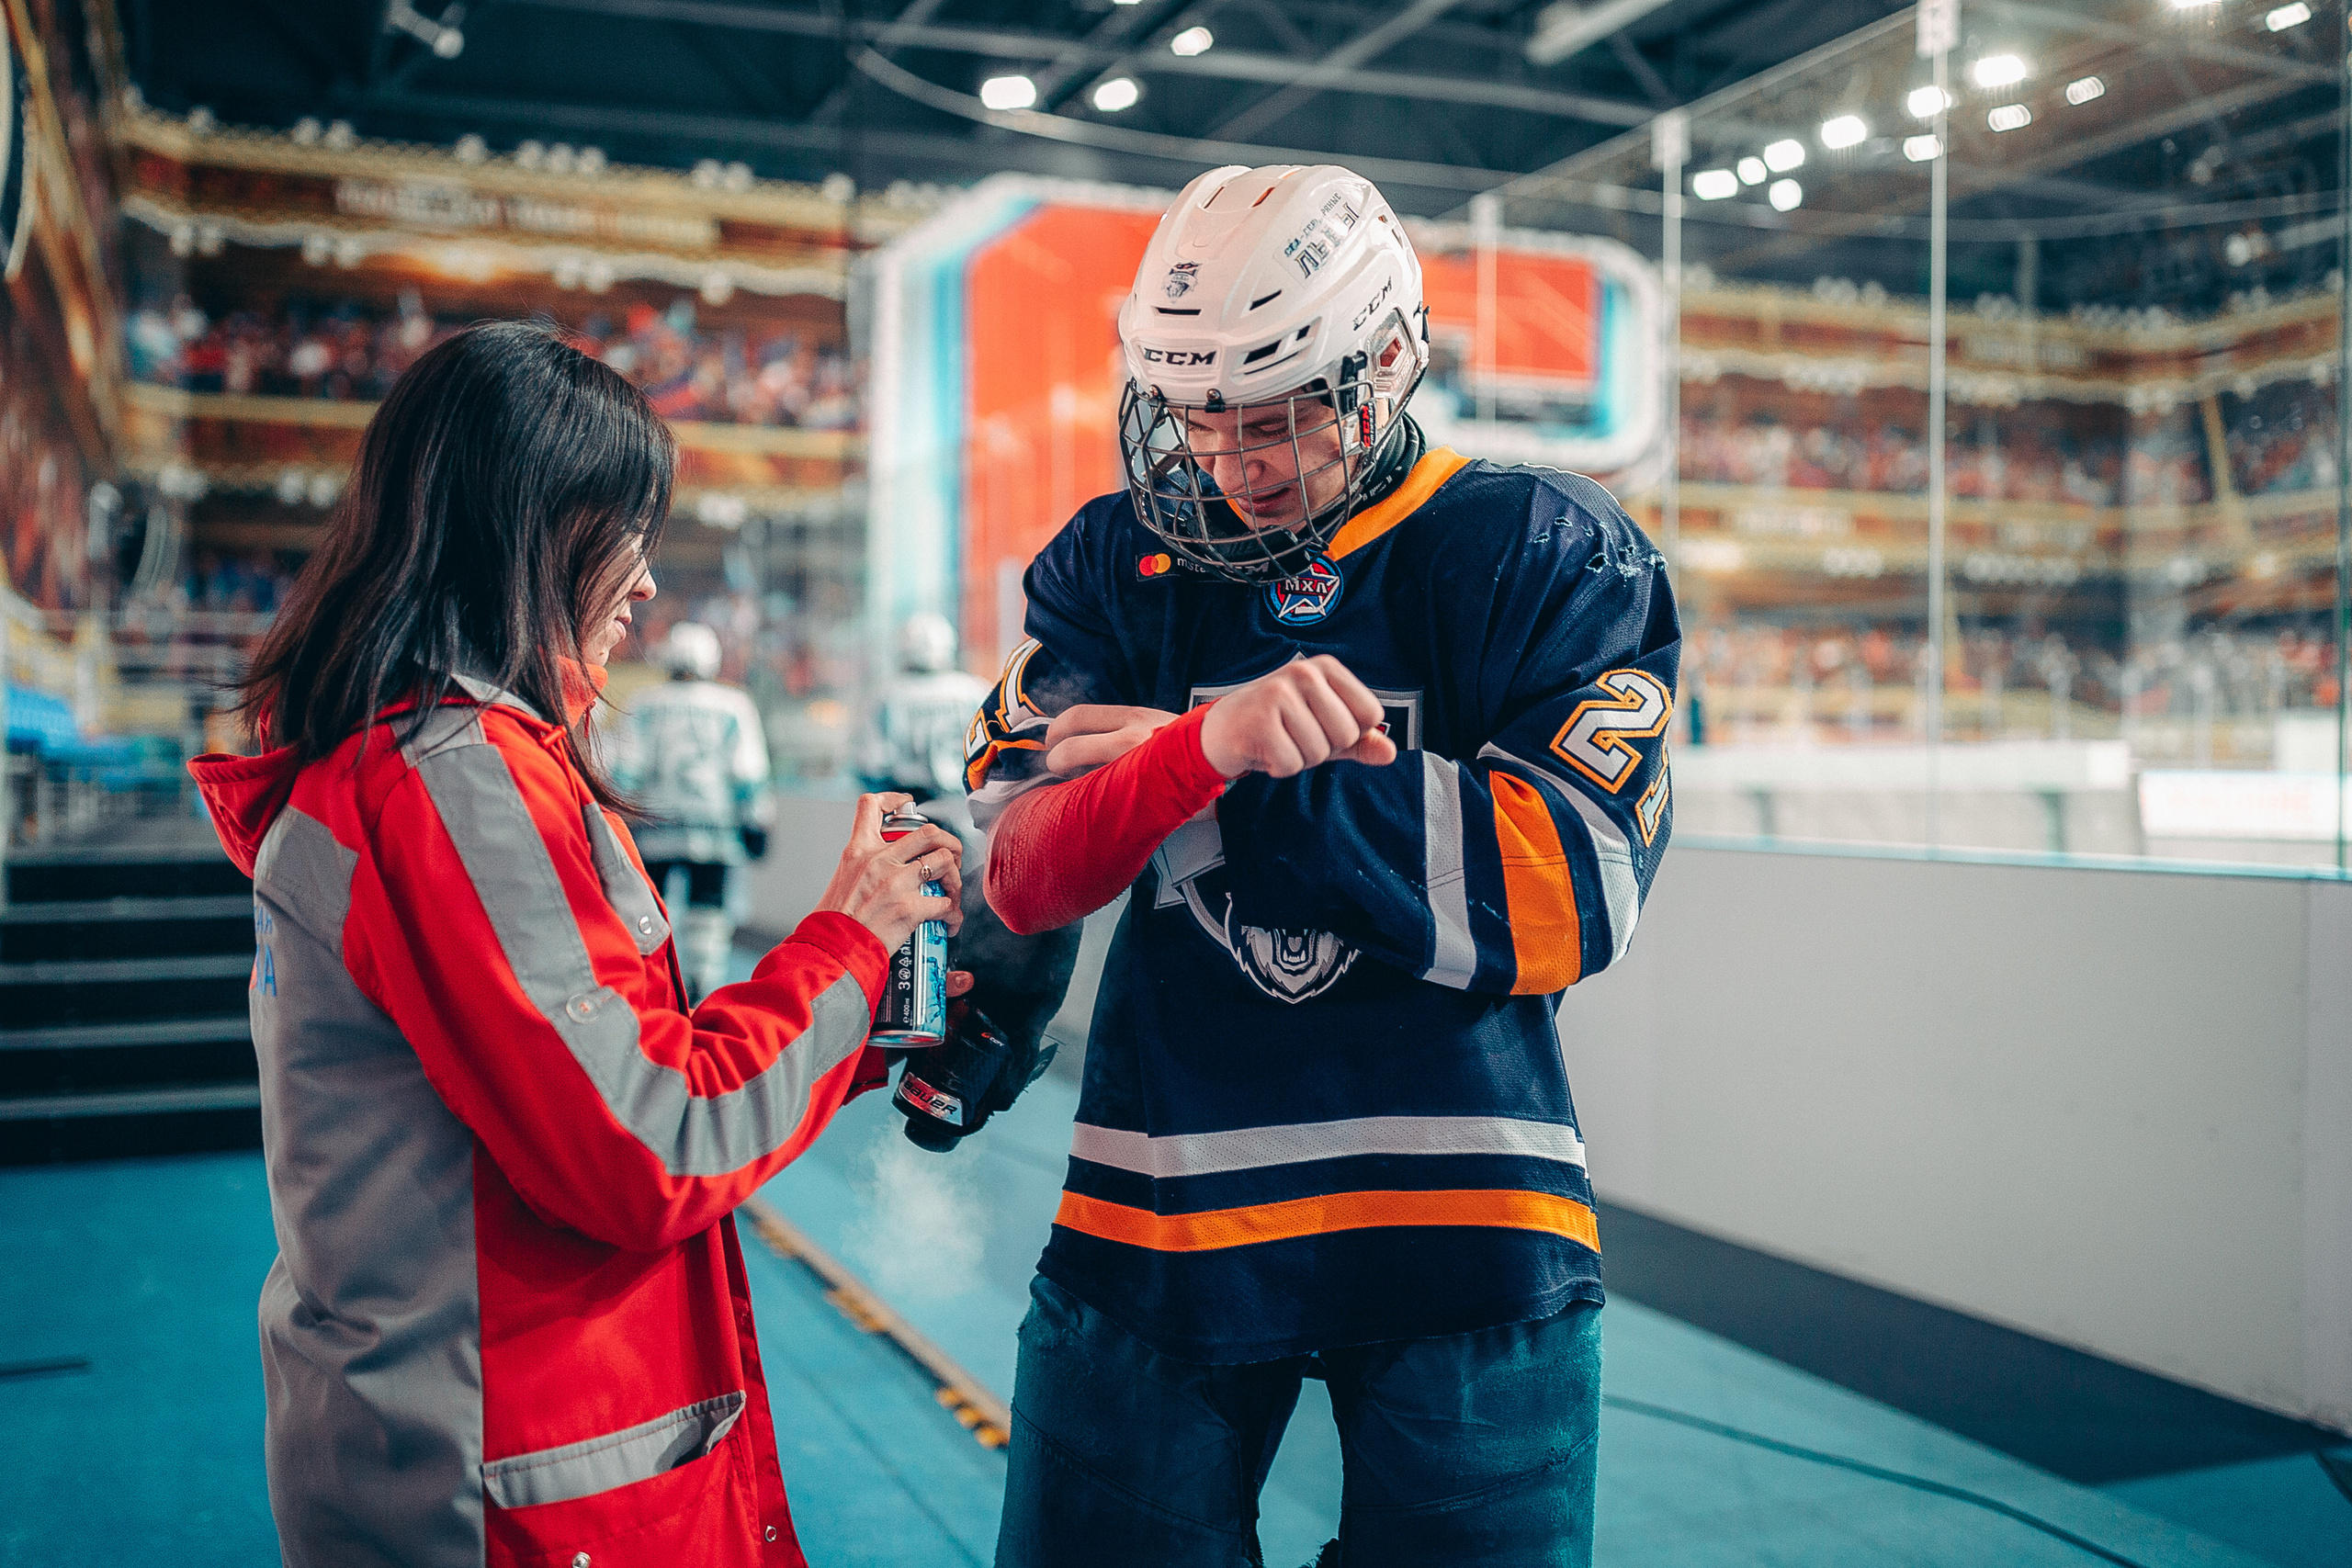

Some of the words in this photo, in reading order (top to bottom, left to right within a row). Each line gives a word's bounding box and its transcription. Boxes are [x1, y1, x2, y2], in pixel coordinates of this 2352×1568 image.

[1352, 275, 1392, 332] CCM
[1143, 347, 1217, 366] CCM
[1363, 405, 1371, 447] CCM
[1284, 578, 1328, 594] МХЛ
